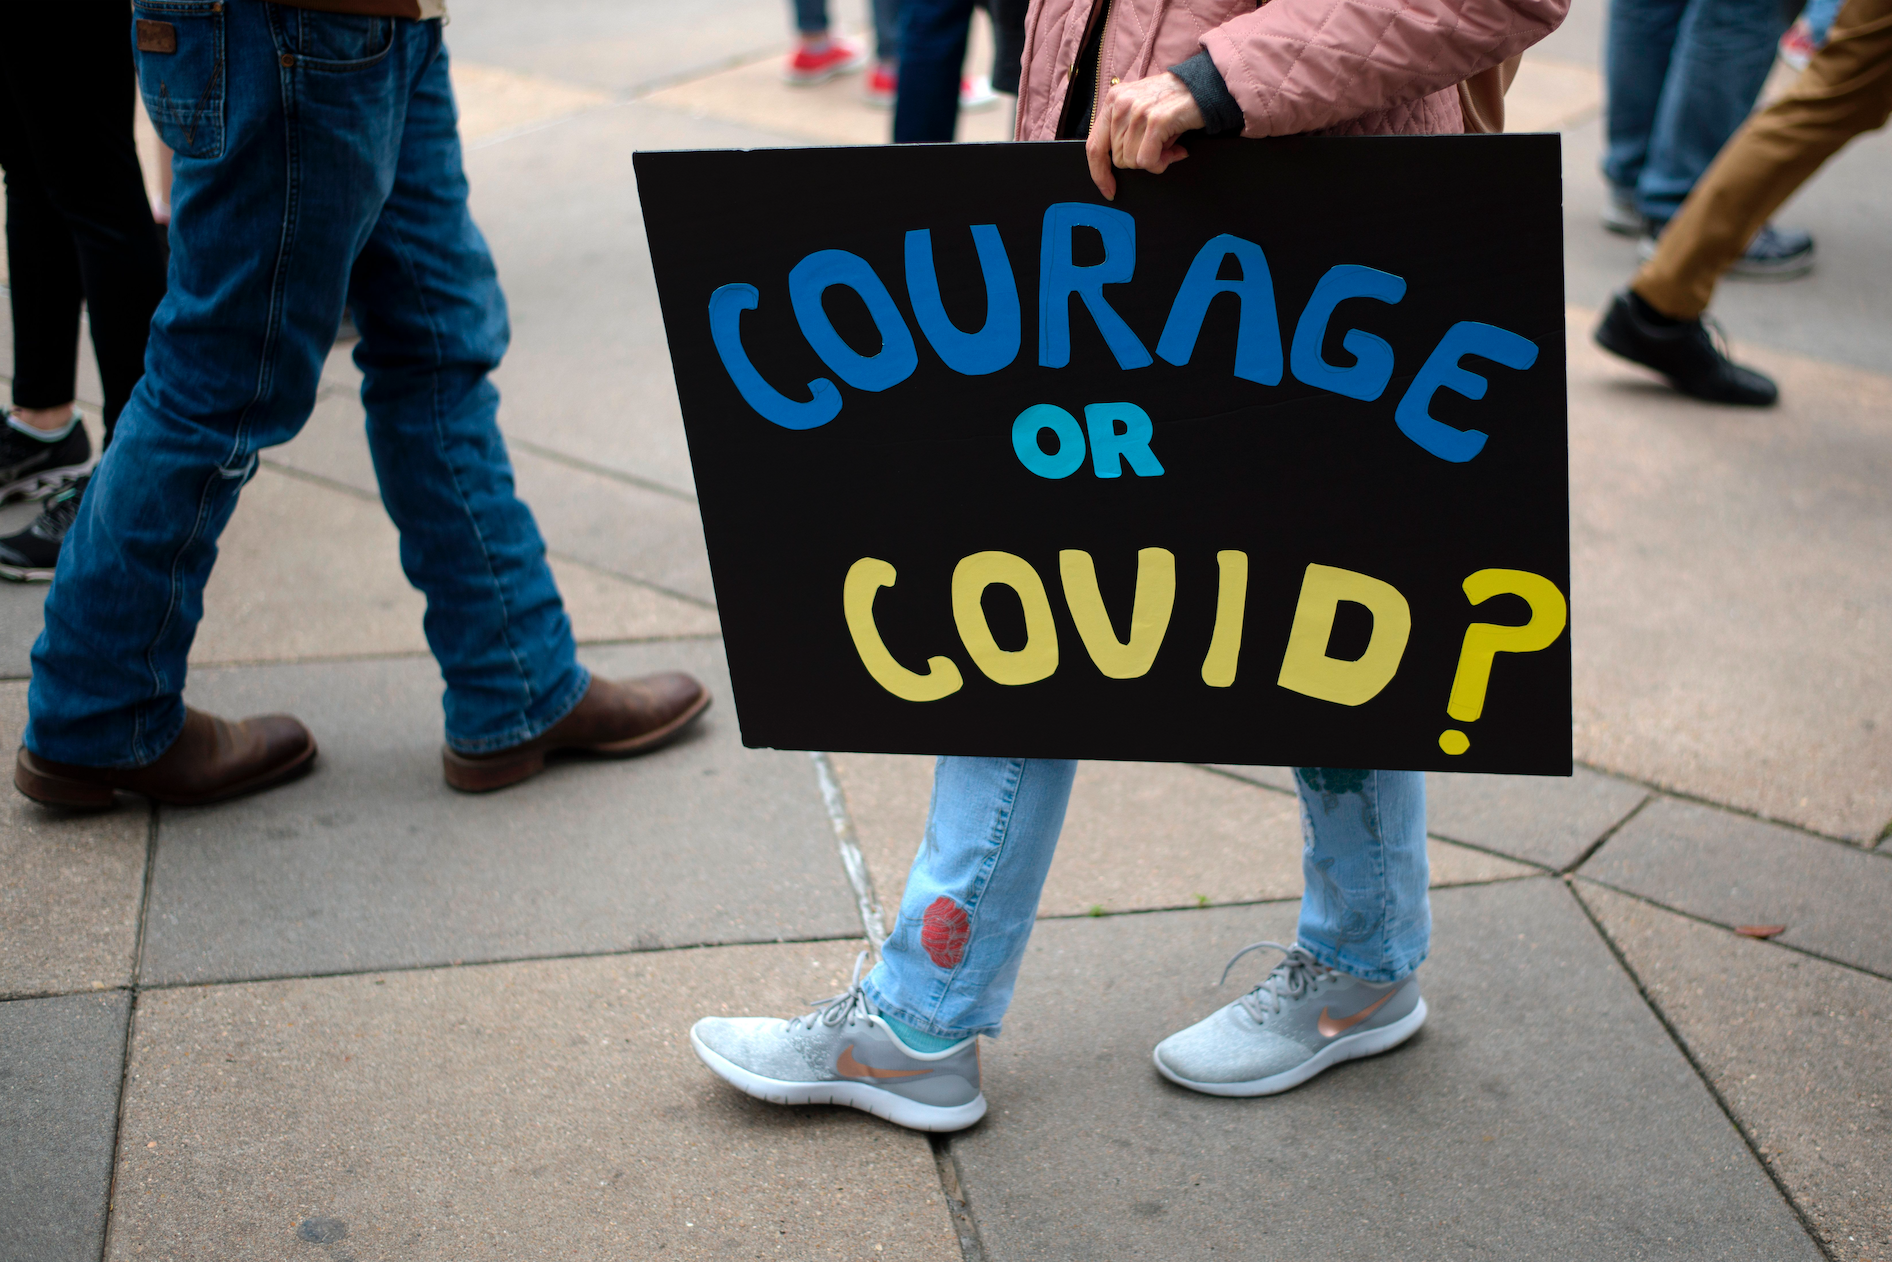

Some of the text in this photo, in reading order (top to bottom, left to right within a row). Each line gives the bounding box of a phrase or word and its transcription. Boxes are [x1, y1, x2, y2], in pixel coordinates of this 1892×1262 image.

[708, 202, 1538, 463] COURAGE
[1012, 402, 1164, 479] OR
[843, 547, 1567, 756] COVID?
